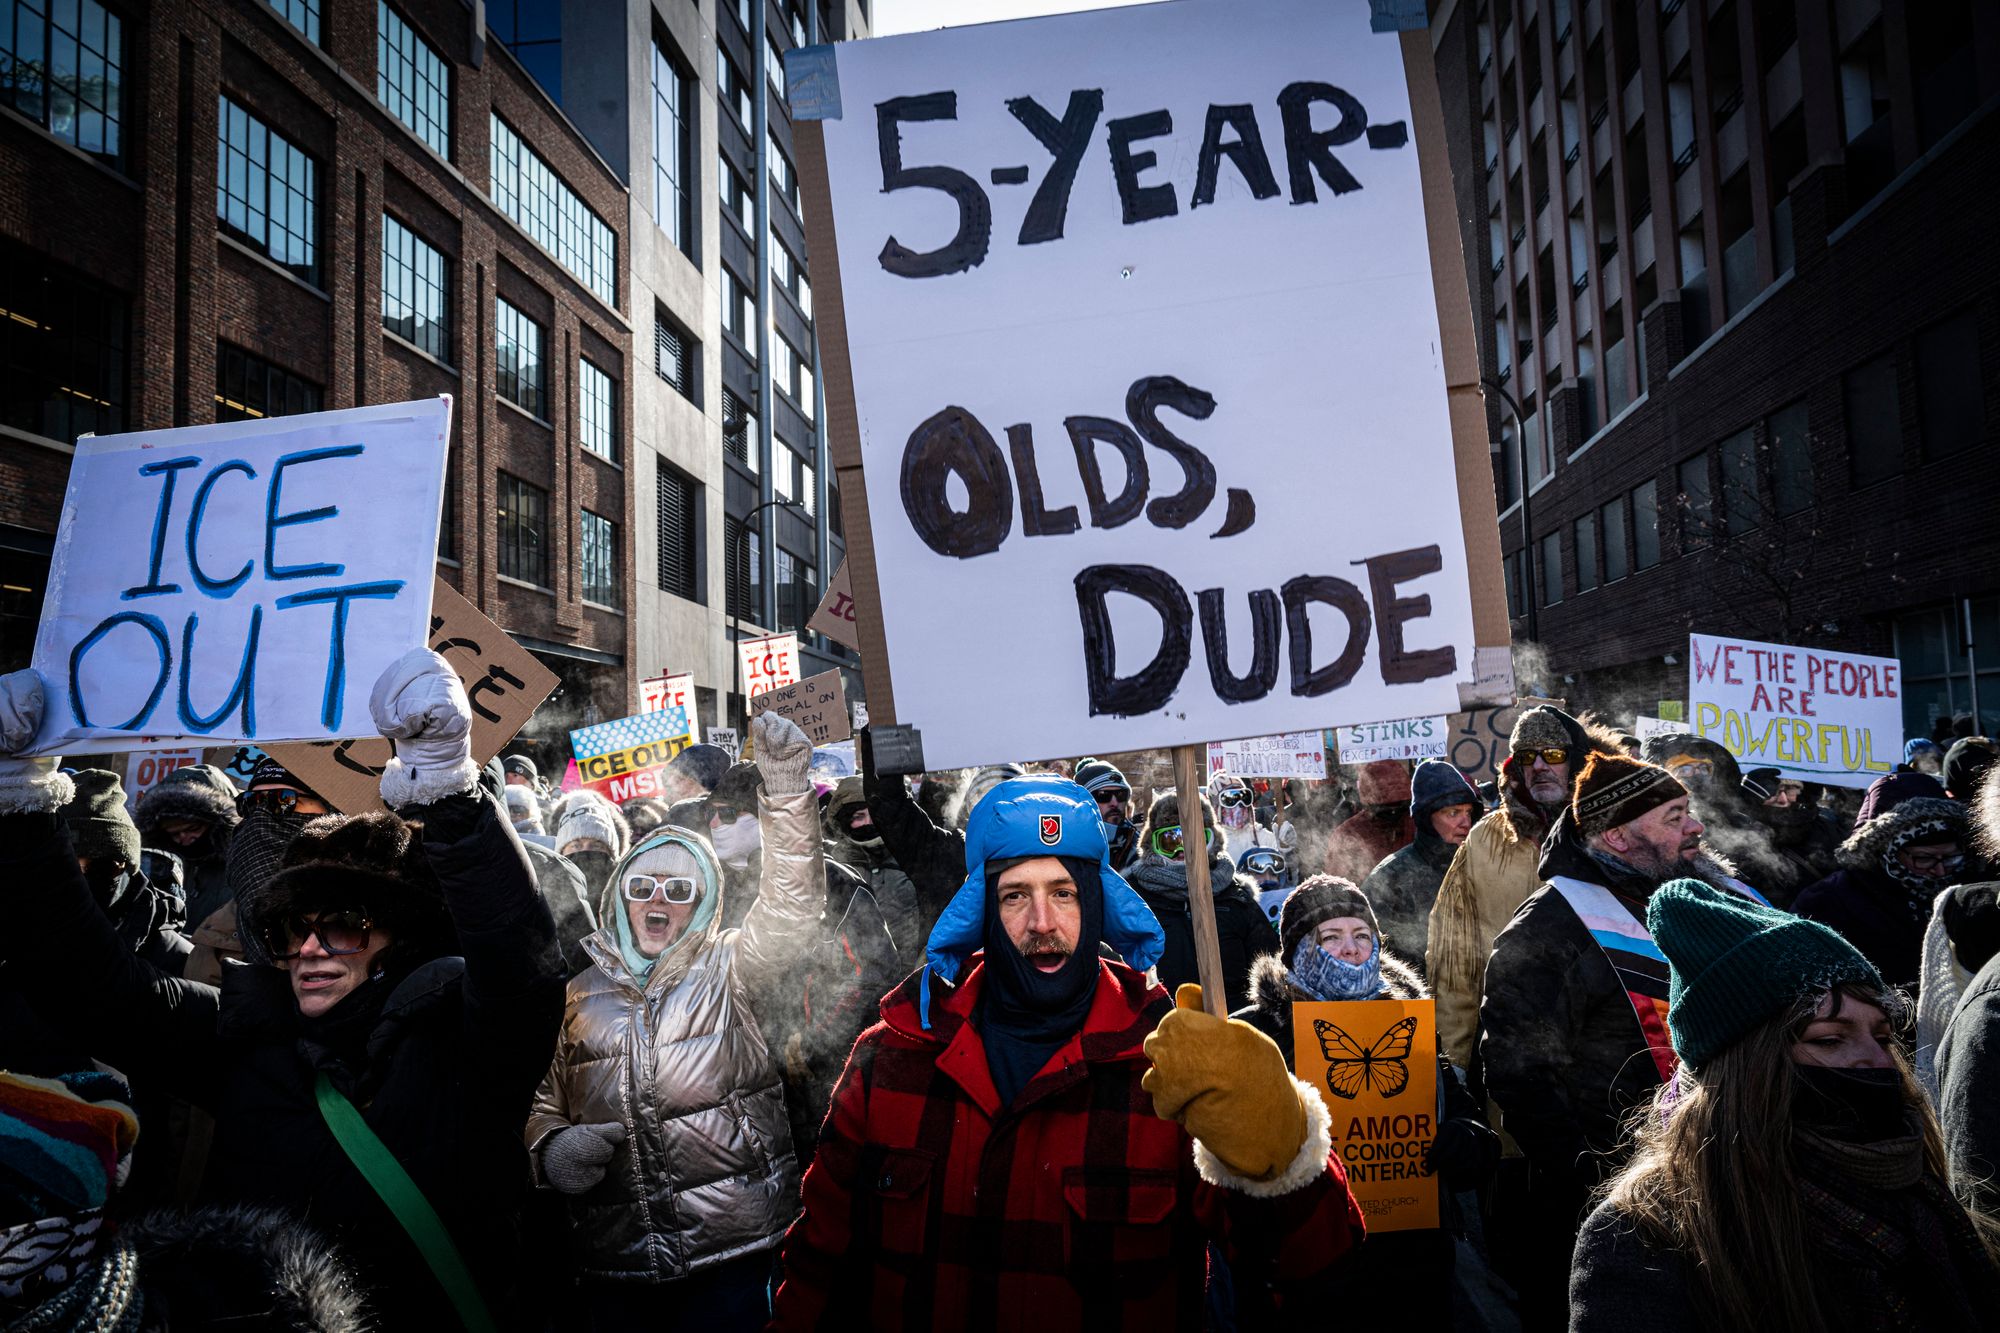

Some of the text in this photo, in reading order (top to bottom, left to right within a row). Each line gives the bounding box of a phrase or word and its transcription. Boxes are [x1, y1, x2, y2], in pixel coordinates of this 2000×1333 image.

[875, 80, 1409, 279] 5-YEAR-
[900, 375, 1256, 560] OLDS,
[120, 444, 365, 600] ICE
[1074, 544, 1458, 718] DUDE
[68, 580, 407, 739] OUT
[748, 652, 790, 679] ICE
[1691, 638, 1898, 699] WE THE PEOPLE
[752, 682, 816, 713] NO ONE IS
[818, 691, 835, 704] ON
[1750, 683, 1817, 717] ARE
[712, 731, 735, 743] STAY
[1351, 720, 1434, 744] STINKS
[1655, 720, 1678, 732] ICE
[1695, 701, 1892, 772] POWERFUL
[579, 735, 689, 783] ICE OUT
[1240, 739, 1301, 752] IS LOUDER
[1340, 740, 1447, 763] (EXCEPT IN DRINKS)
[1225, 752, 1264, 774] THAN
[1264, 752, 1293, 774] YOUR
[1346, 1113, 1431, 1141] AMOR
[1343, 1139, 1432, 1162] CONOCE
[1364, 1206, 1393, 1217] CHRIST
[1381, 1196, 1419, 1207] CHURCH
